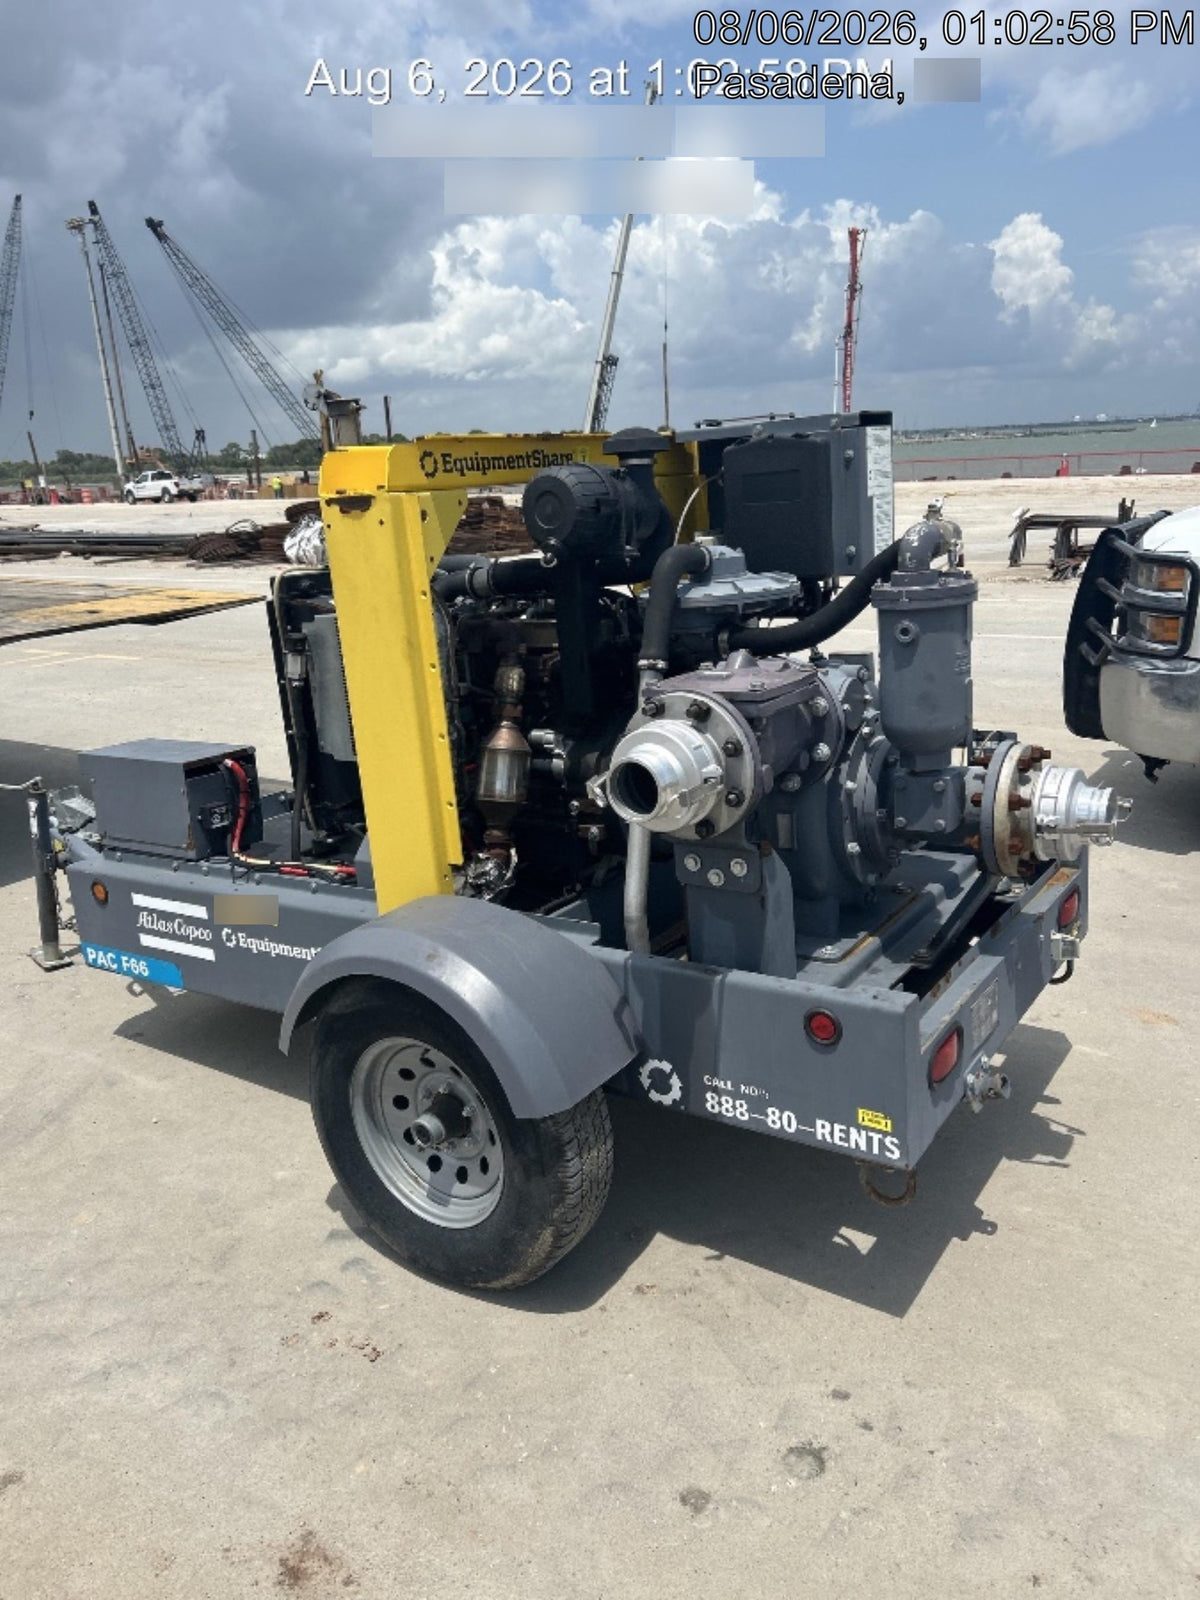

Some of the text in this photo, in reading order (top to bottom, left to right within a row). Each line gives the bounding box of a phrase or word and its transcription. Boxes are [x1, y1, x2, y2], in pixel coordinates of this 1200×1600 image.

[440, 449, 573, 477] EquipmentShare
[136, 911, 213, 942] Atlas Copco
[86, 947, 149, 977] PAC F66
[703, 1074, 735, 1091] CALL
[704, 1090, 901, 1160] 888-80-RENTS
